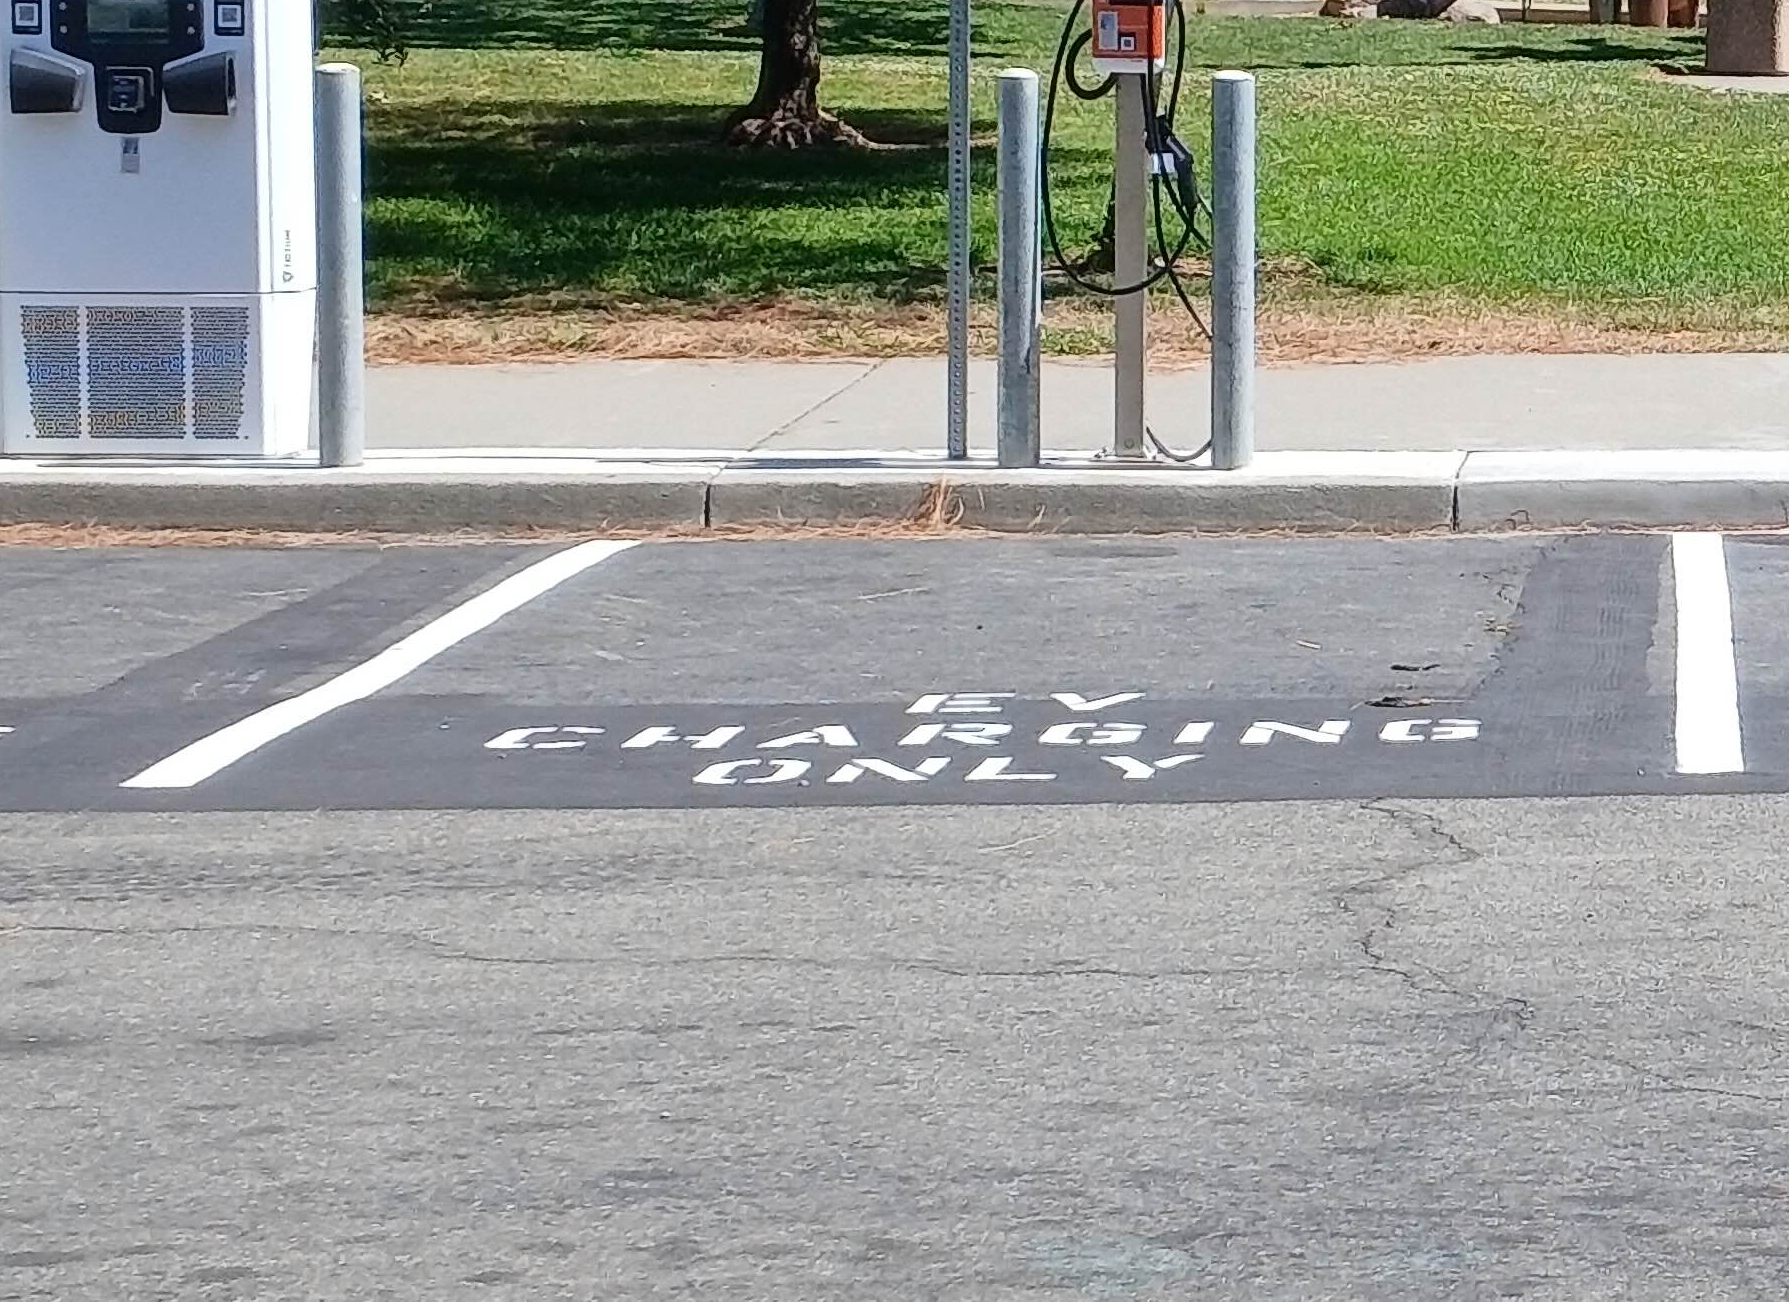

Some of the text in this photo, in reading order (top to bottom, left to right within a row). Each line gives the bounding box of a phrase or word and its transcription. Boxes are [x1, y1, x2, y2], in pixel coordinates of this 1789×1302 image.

[906, 692, 1147, 713] EV
[484, 718, 1482, 750] CHARGING
[693, 753, 1204, 785] ONLY
